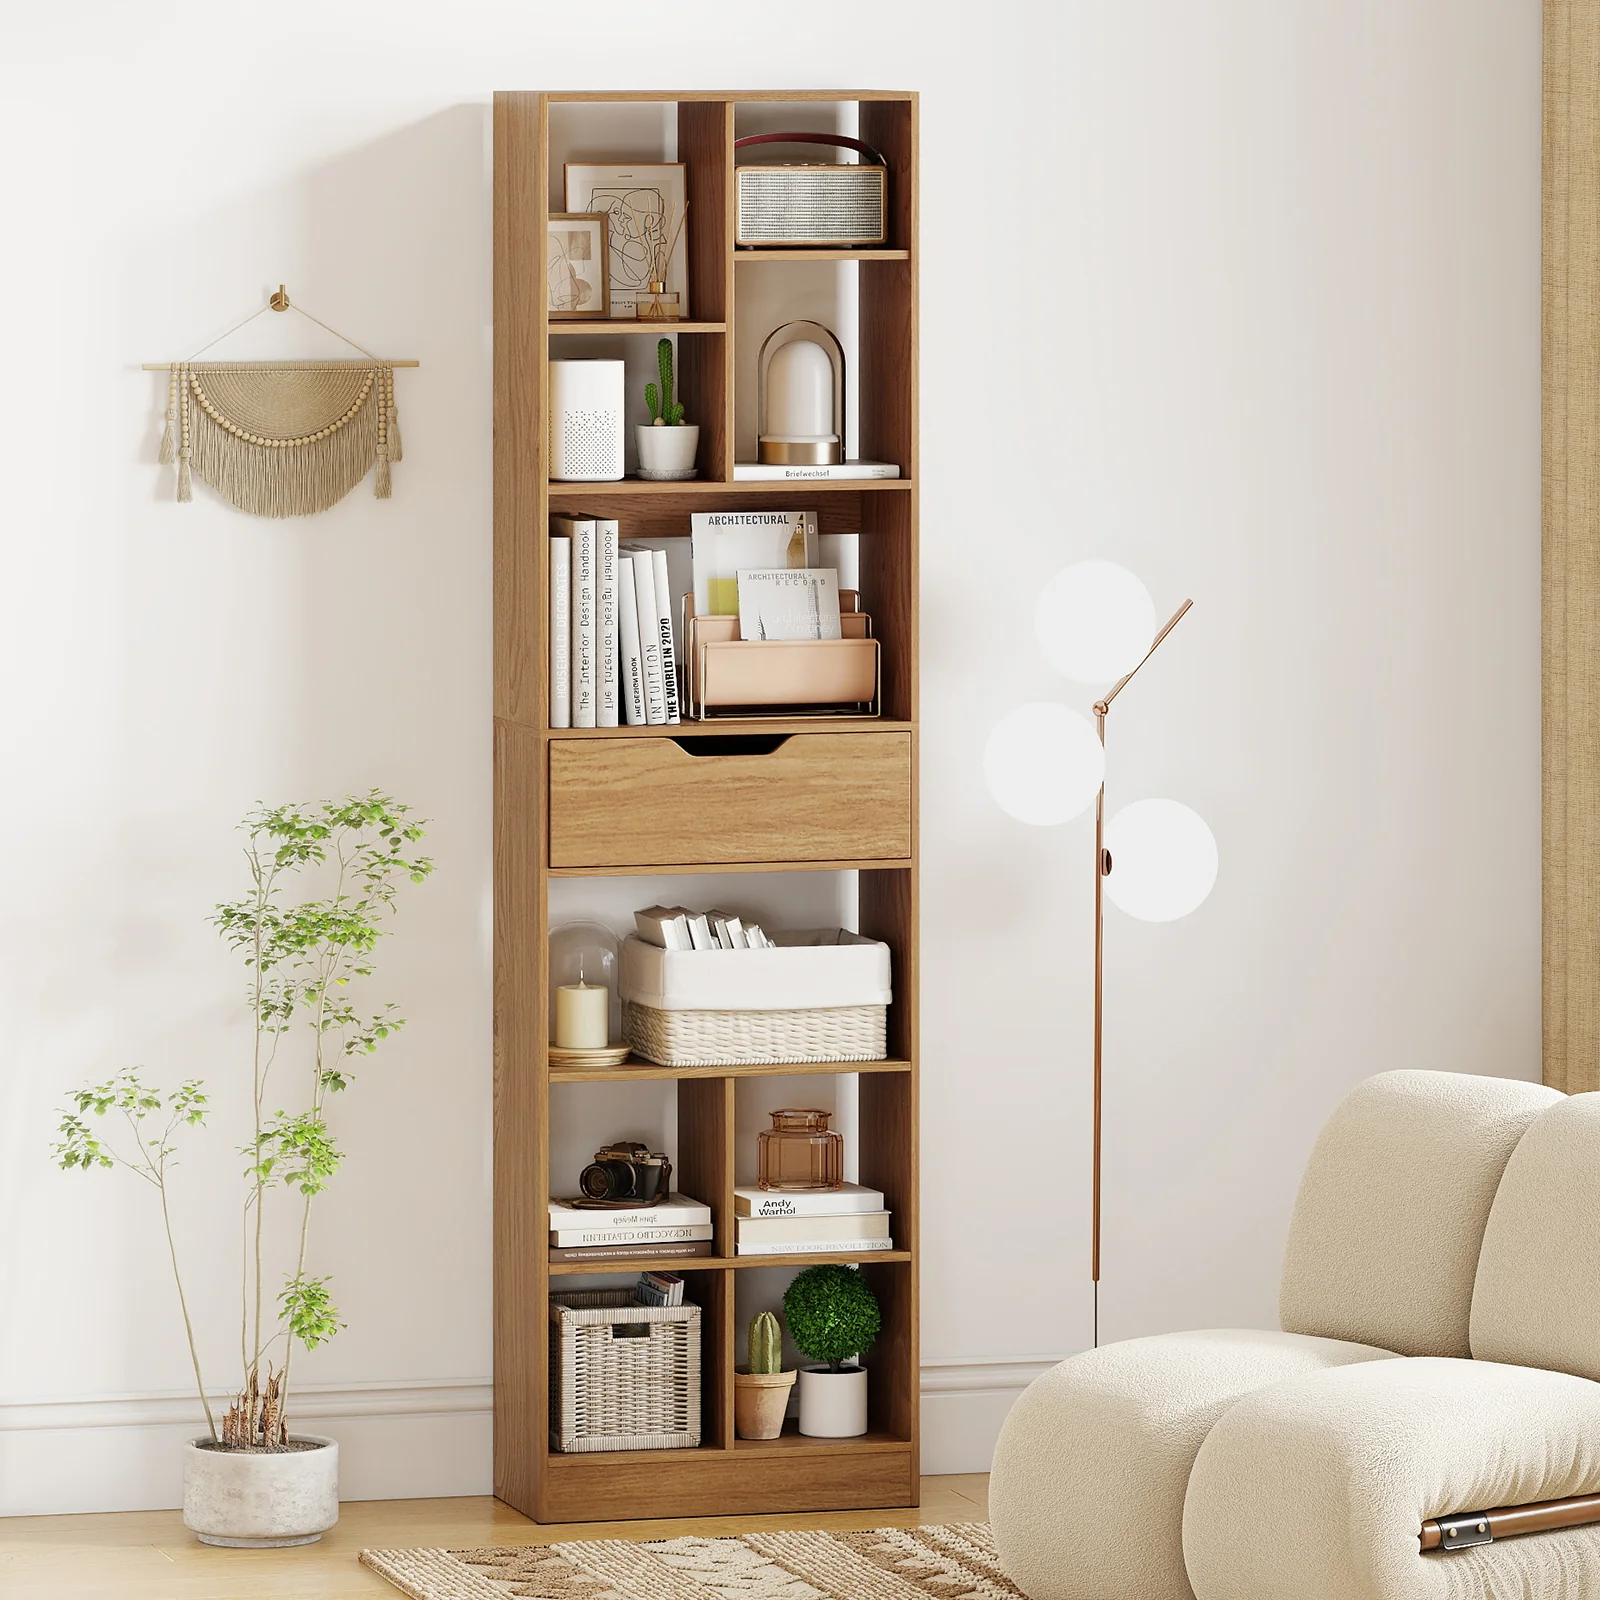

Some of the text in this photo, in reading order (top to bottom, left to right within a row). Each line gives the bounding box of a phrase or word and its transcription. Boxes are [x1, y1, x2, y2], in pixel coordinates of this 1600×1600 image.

[708, 515, 789, 525] ARCHITECTURAL
[556, 563, 567, 698] HOUSEHOLD DECORATES
[580, 529, 592, 710] The Interior Design Handbook
[646, 644, 663, 720] INTUITION
[660, 617, 678, 720] THE WORLD IN 2020
[758, 1207, 796, 1216] Warhol
[762, 1200, 792, 1208] Andy
[826, 1242, 889, 1250] REVOLUTION
